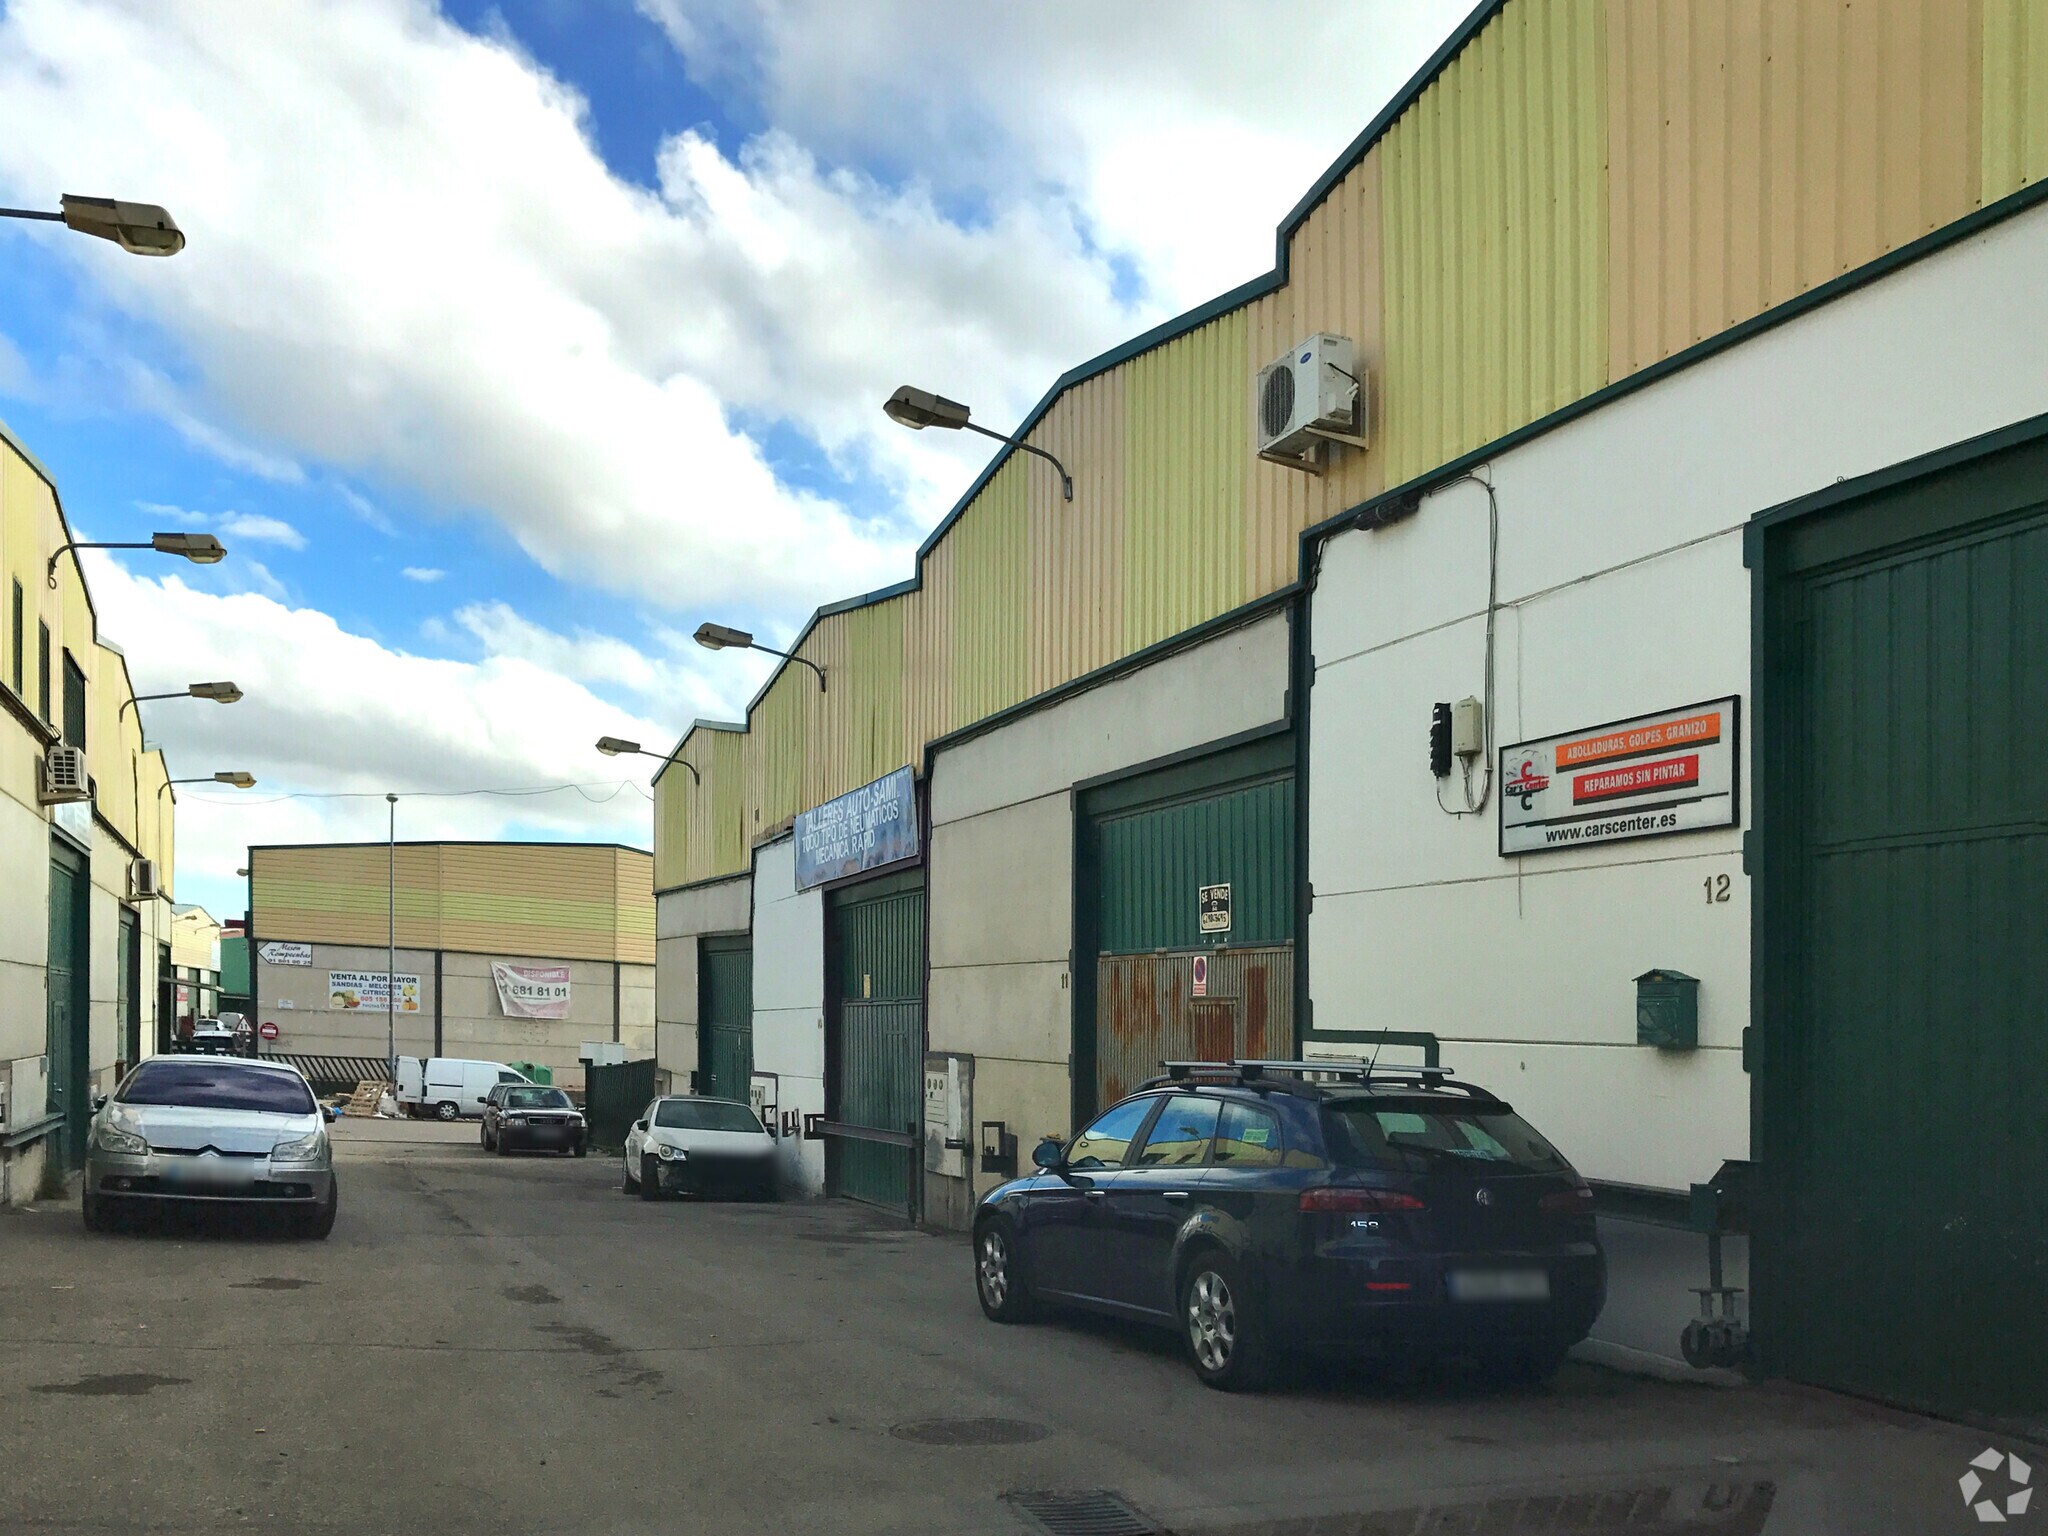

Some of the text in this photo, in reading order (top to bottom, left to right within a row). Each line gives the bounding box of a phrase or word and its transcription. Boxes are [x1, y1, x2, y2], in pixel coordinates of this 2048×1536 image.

[1567, 720, 1707, 760] ABOLLADURAS, GOLPES, GRANIZO
[1524, 778, 1549, 791] Center
[1584, 763, 1685, 793] REPARAMOS SIN PINTAR
[801, 833, 820, 853] TODO
[839, 820, 849, 840] DE
[1546, 813, 1677, 842] www.carscenter.es
[1201, 888, 1228, 904] SE VENDE
[1703, 873, 1730, 904] 12
[330, 973, 357, 981] VENTA
[359, 974, 370, 982] AL
[389, 976, 417, 984] AYOR
[523, 969, 565, 979] DISPONIBLE
[512, 985, 533, 996] 681
[537, 986, 550, 997] 81
[554, 987, 567, 997] 01
